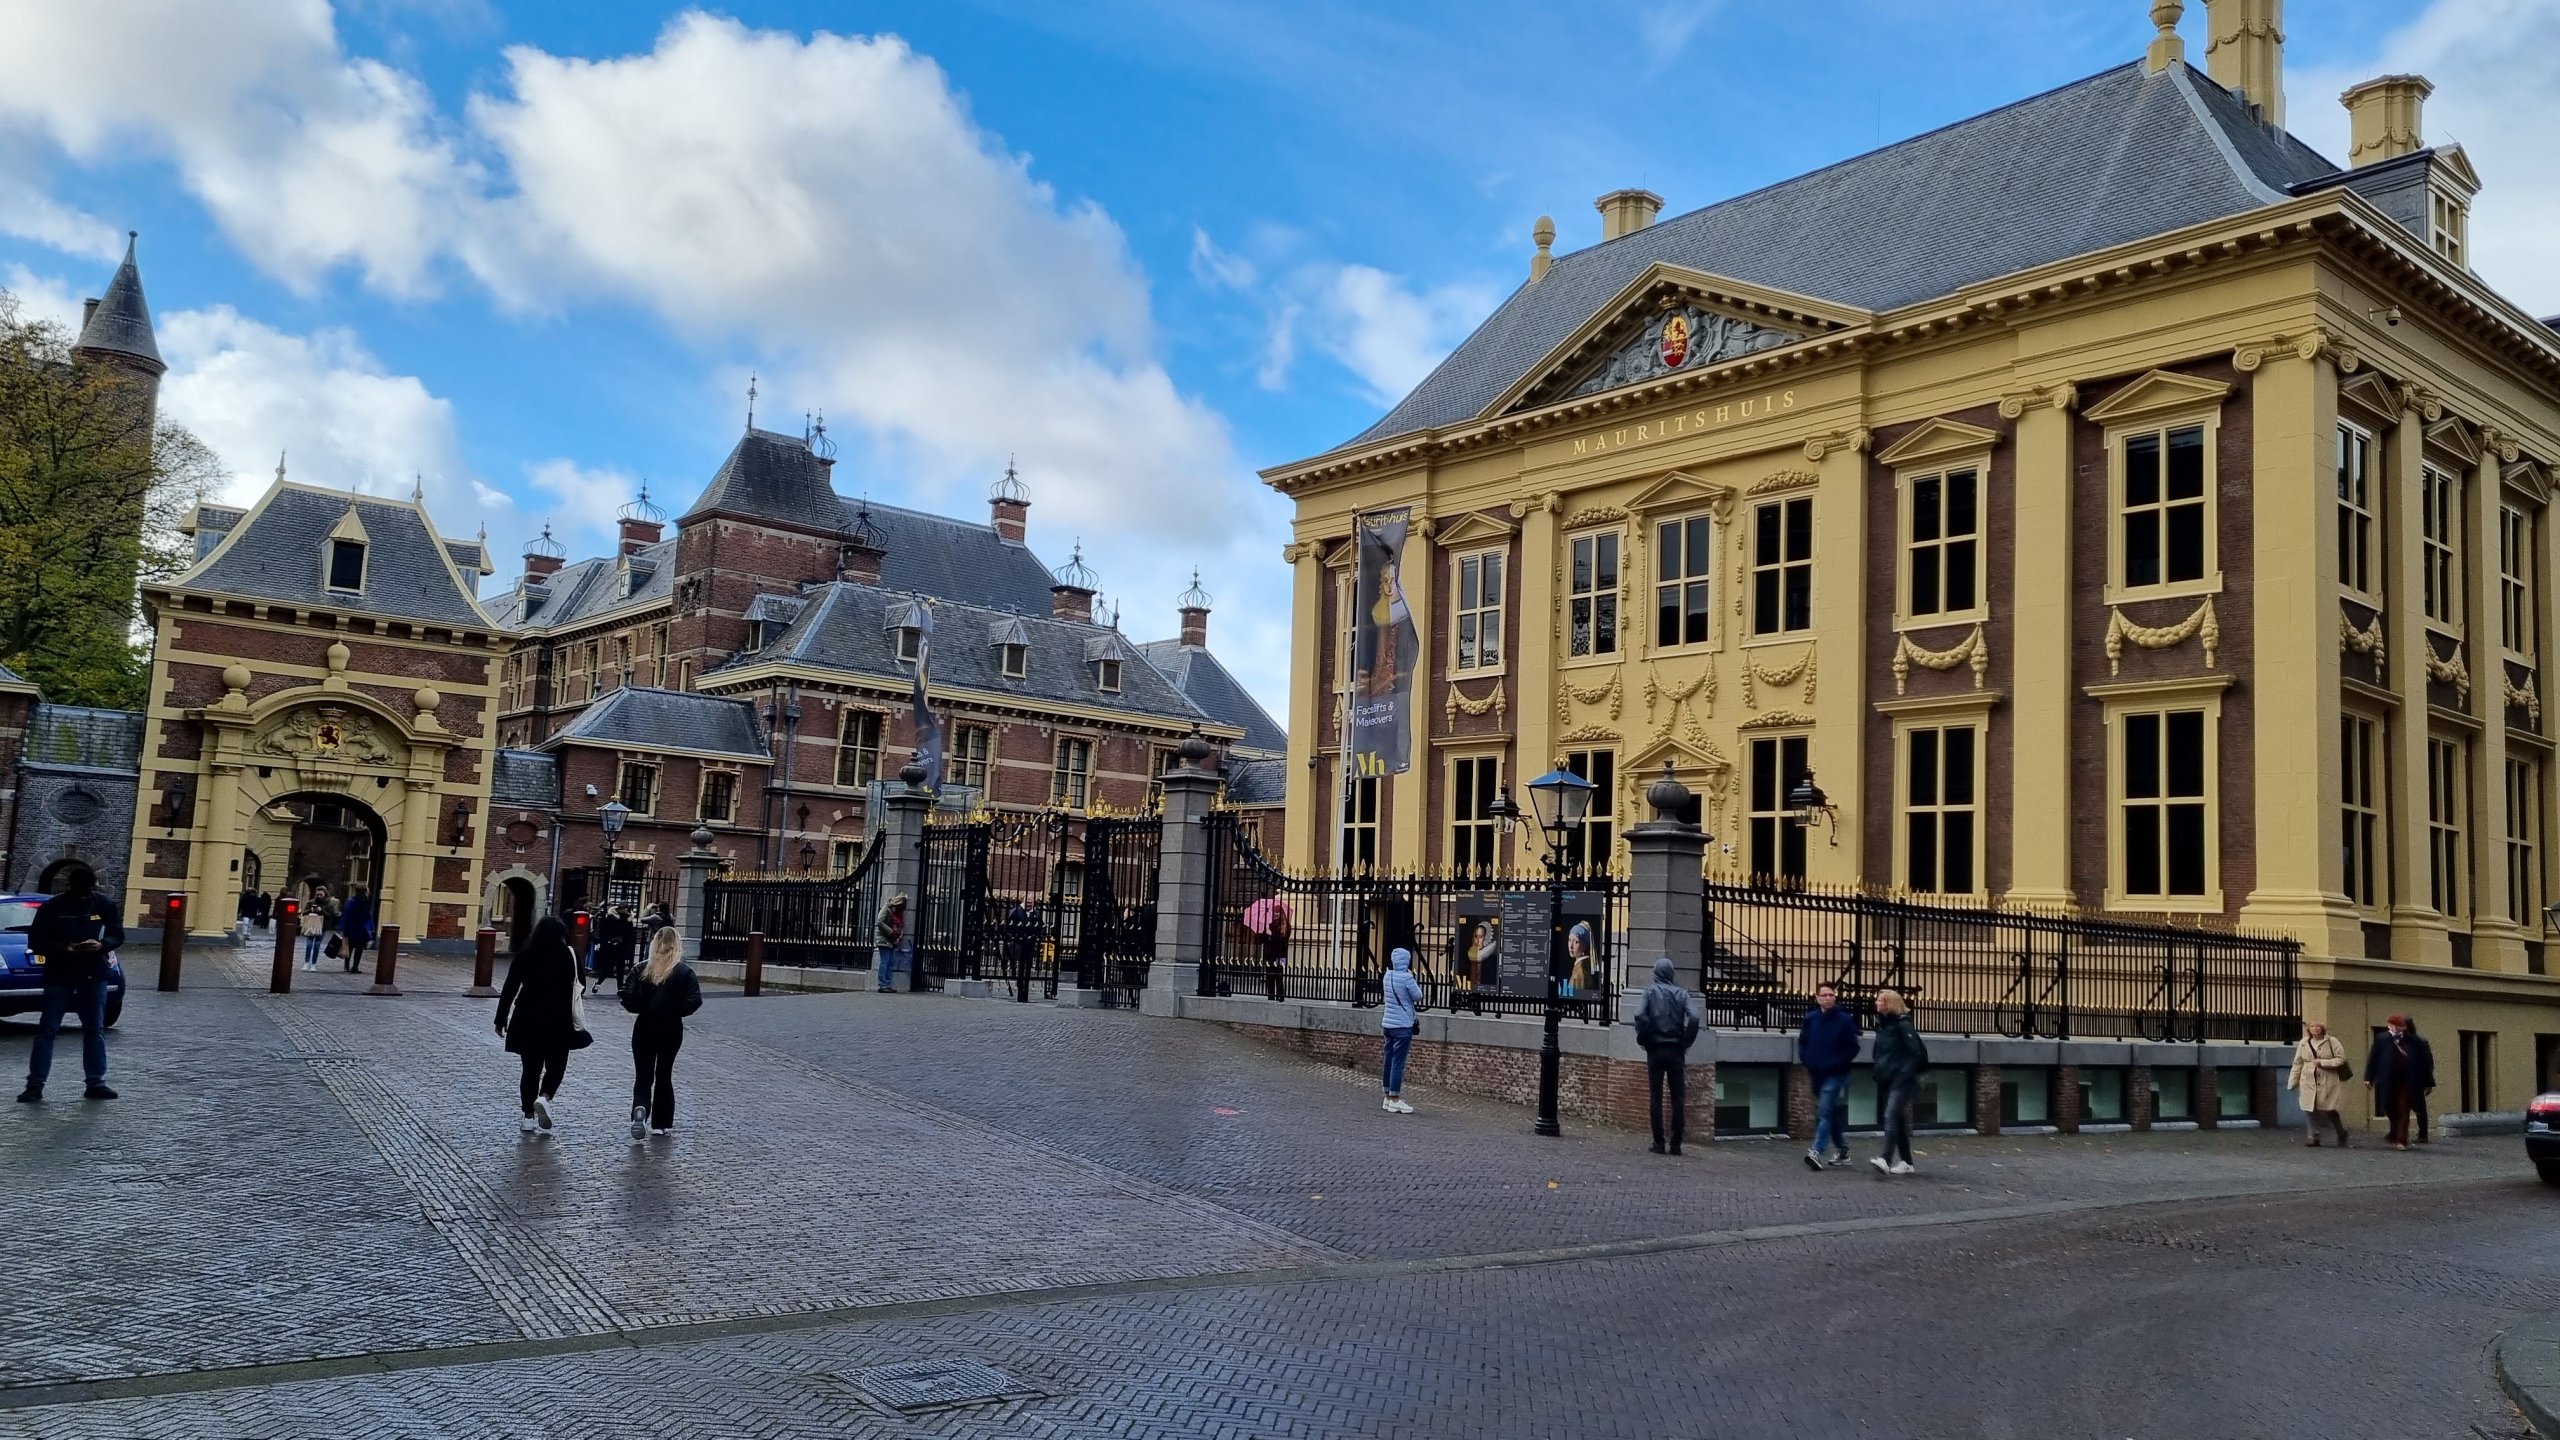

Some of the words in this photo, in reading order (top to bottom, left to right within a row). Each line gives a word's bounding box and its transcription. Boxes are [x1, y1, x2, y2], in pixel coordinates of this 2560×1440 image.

[1572, 391, 1794, 454] MAURITSHUIS
[1356, 703, 1387, 715] Facelifts
[1387, 701, 1394, 711] &
